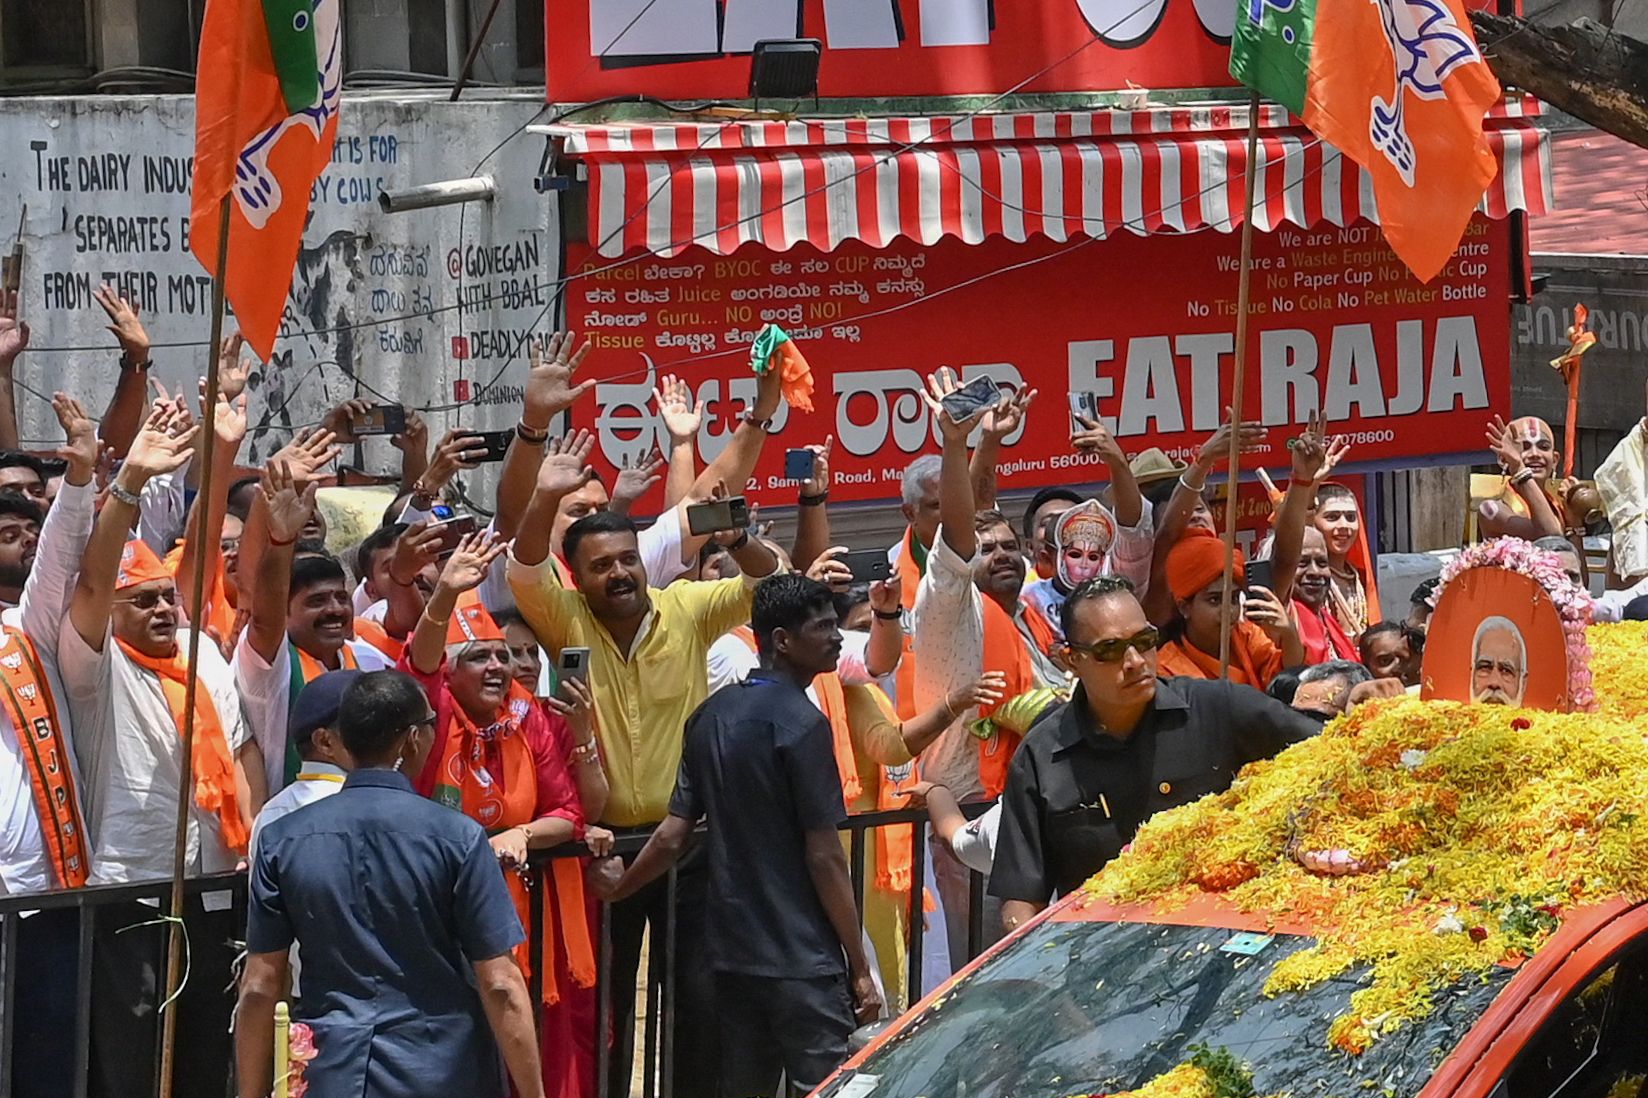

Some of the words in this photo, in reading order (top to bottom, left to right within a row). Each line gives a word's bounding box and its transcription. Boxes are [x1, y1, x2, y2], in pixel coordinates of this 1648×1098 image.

[348, 136, 363, 164] IS
[369, 135, 397, 164] FOR
[31, 140, 71, 192] THE
[78, 153, 131, 192] DAIRY
[74, 214, 170, 254] SEPARATES
[1279, 231, 1301, 247] We
[1306, 232, 1332, 247] are
[1338, 227, 1370, 245] NOT
[584, 262, 640, 281] Parcel
[715, 259, 761, 278] BYOC
[835, 256, 869, 273] CUP
[1217, 255, 1240, 271] We
[1276, 257, 1286, 269] a
[1291, 249, 1338, 267] Waste
[1267, 273, 1288, 289] No
[1294, 271, 1339, 291] Paper
[1344, 269, 1373, 287] Cup
[1378, 265, 1399, 282] No
[1459, 260, 1487, 279] Cup
[44, 271, 92, 310] FROM
[102, 271, 158, 313] THEIR
[677, 285, 721, 303] Juice
[1187, 300, 1209, 318] No
[1215, 298, 1266, 316] Tisue
[1272, 297, 1294, 314] No
[1299, 294, 1332, 311] Cola
[1338, 292, 1359, 309] No
[1364, 290, 1390, 306] Pet
[1394, 288, 1437, 304] Water
[1442, 283, 1487, 301] Bottle
[726, 307, 752, 324] NO
[810, 302, 842, 320] NO!
[584, 331, 644, 348] Tissue
[1067, 332, 1234, 438] EAT
[1260, 315, 1490, 427] RAJA
[834, 468, 876, 485] Road,
[995, 458, 1045, 477] ngaluru
[1050, 452, 1105, 469] 56000
